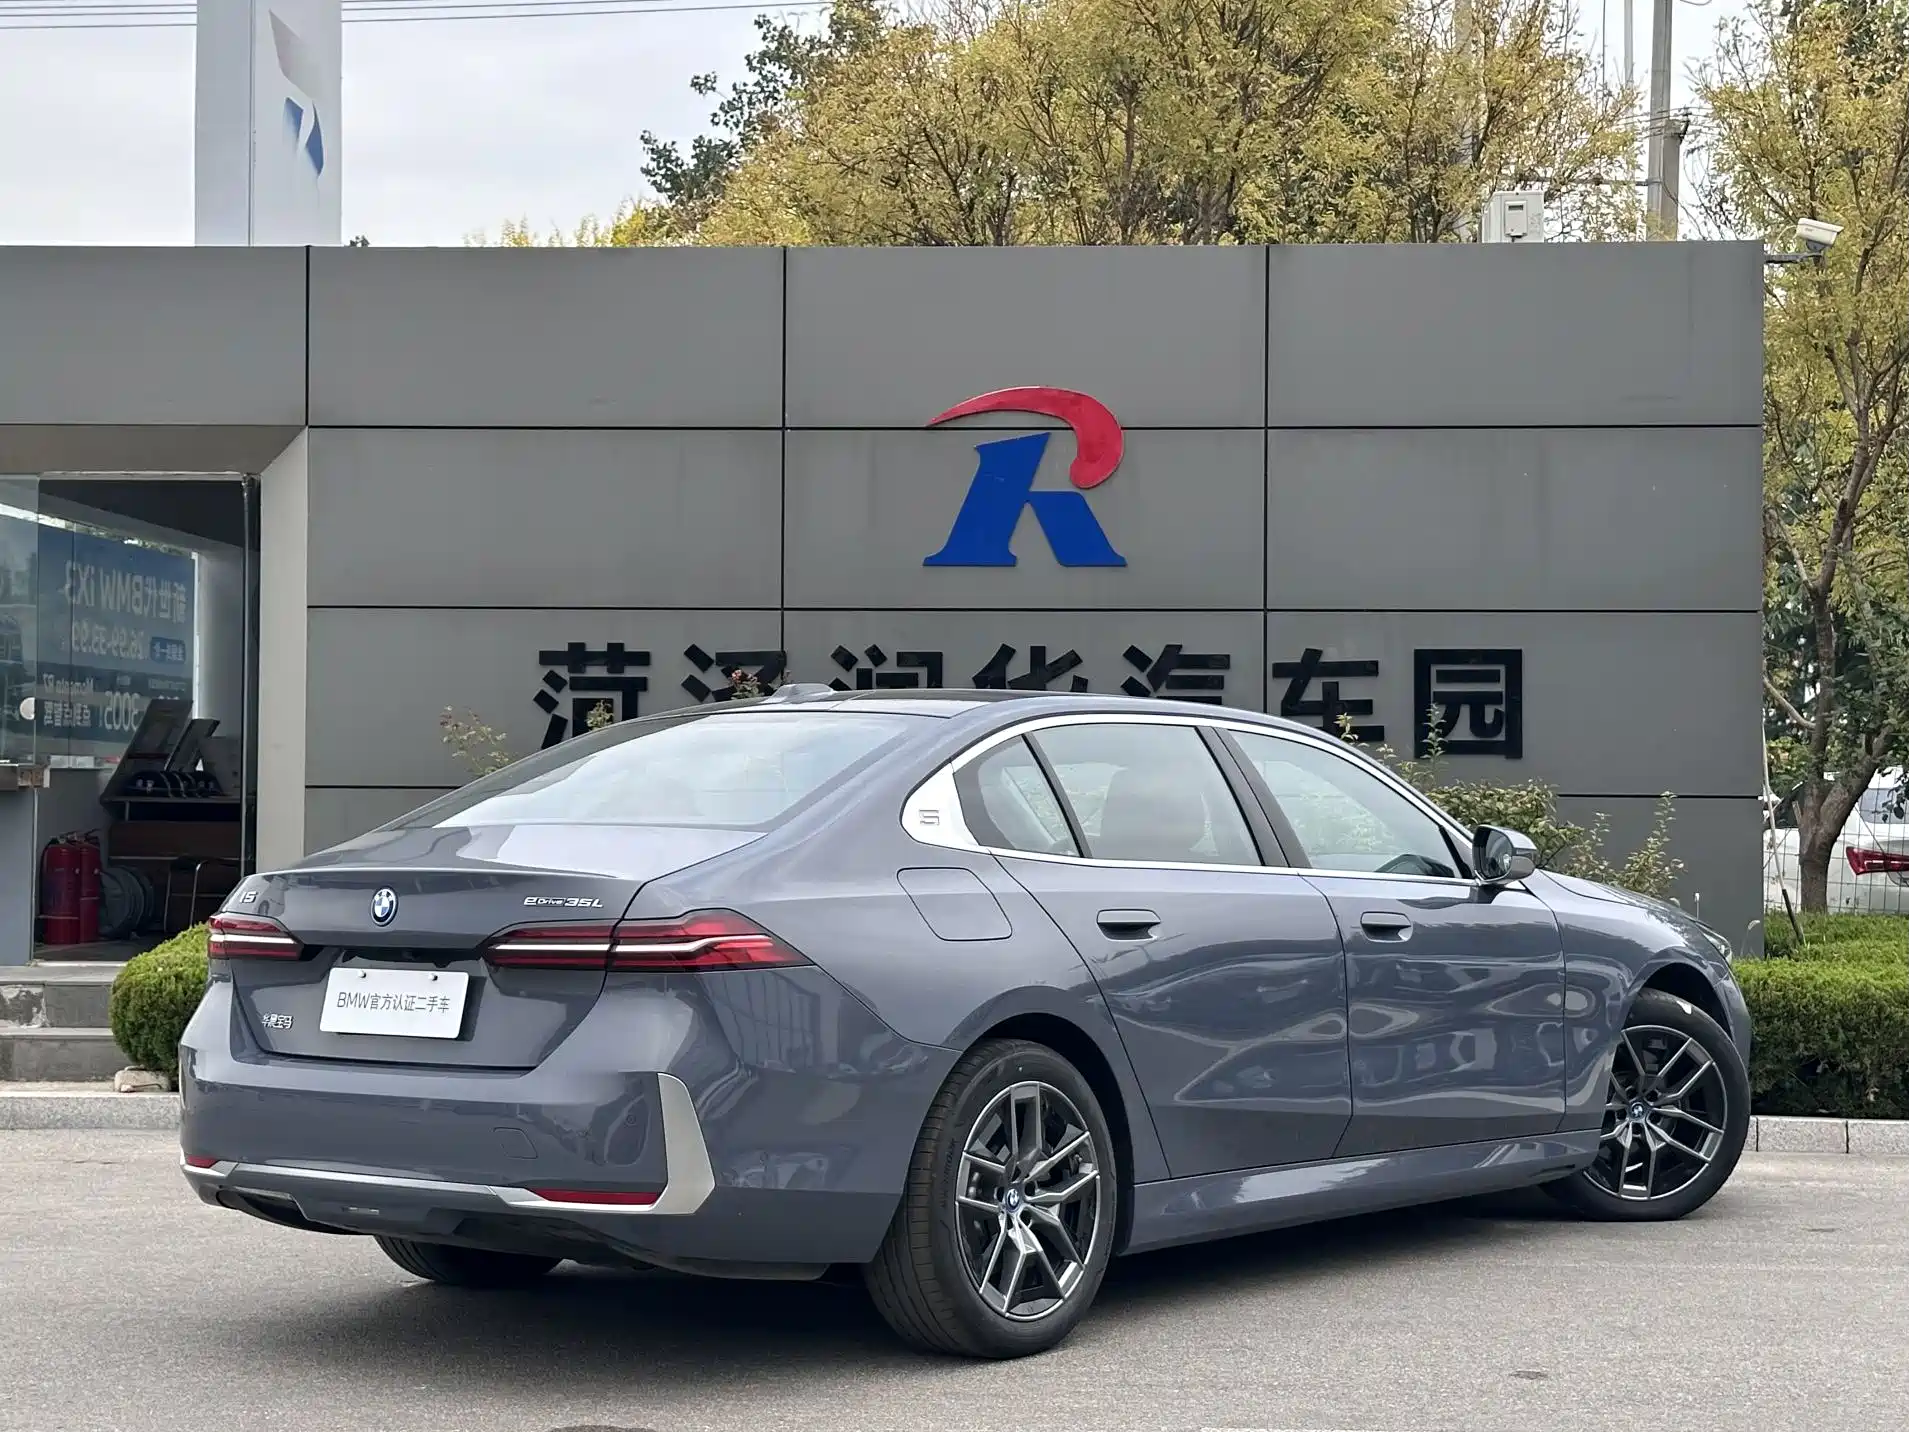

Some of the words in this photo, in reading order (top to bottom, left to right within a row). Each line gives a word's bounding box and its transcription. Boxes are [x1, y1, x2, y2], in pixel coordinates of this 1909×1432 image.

[336, 991, 451, 1014] BMW官方认证二手车
